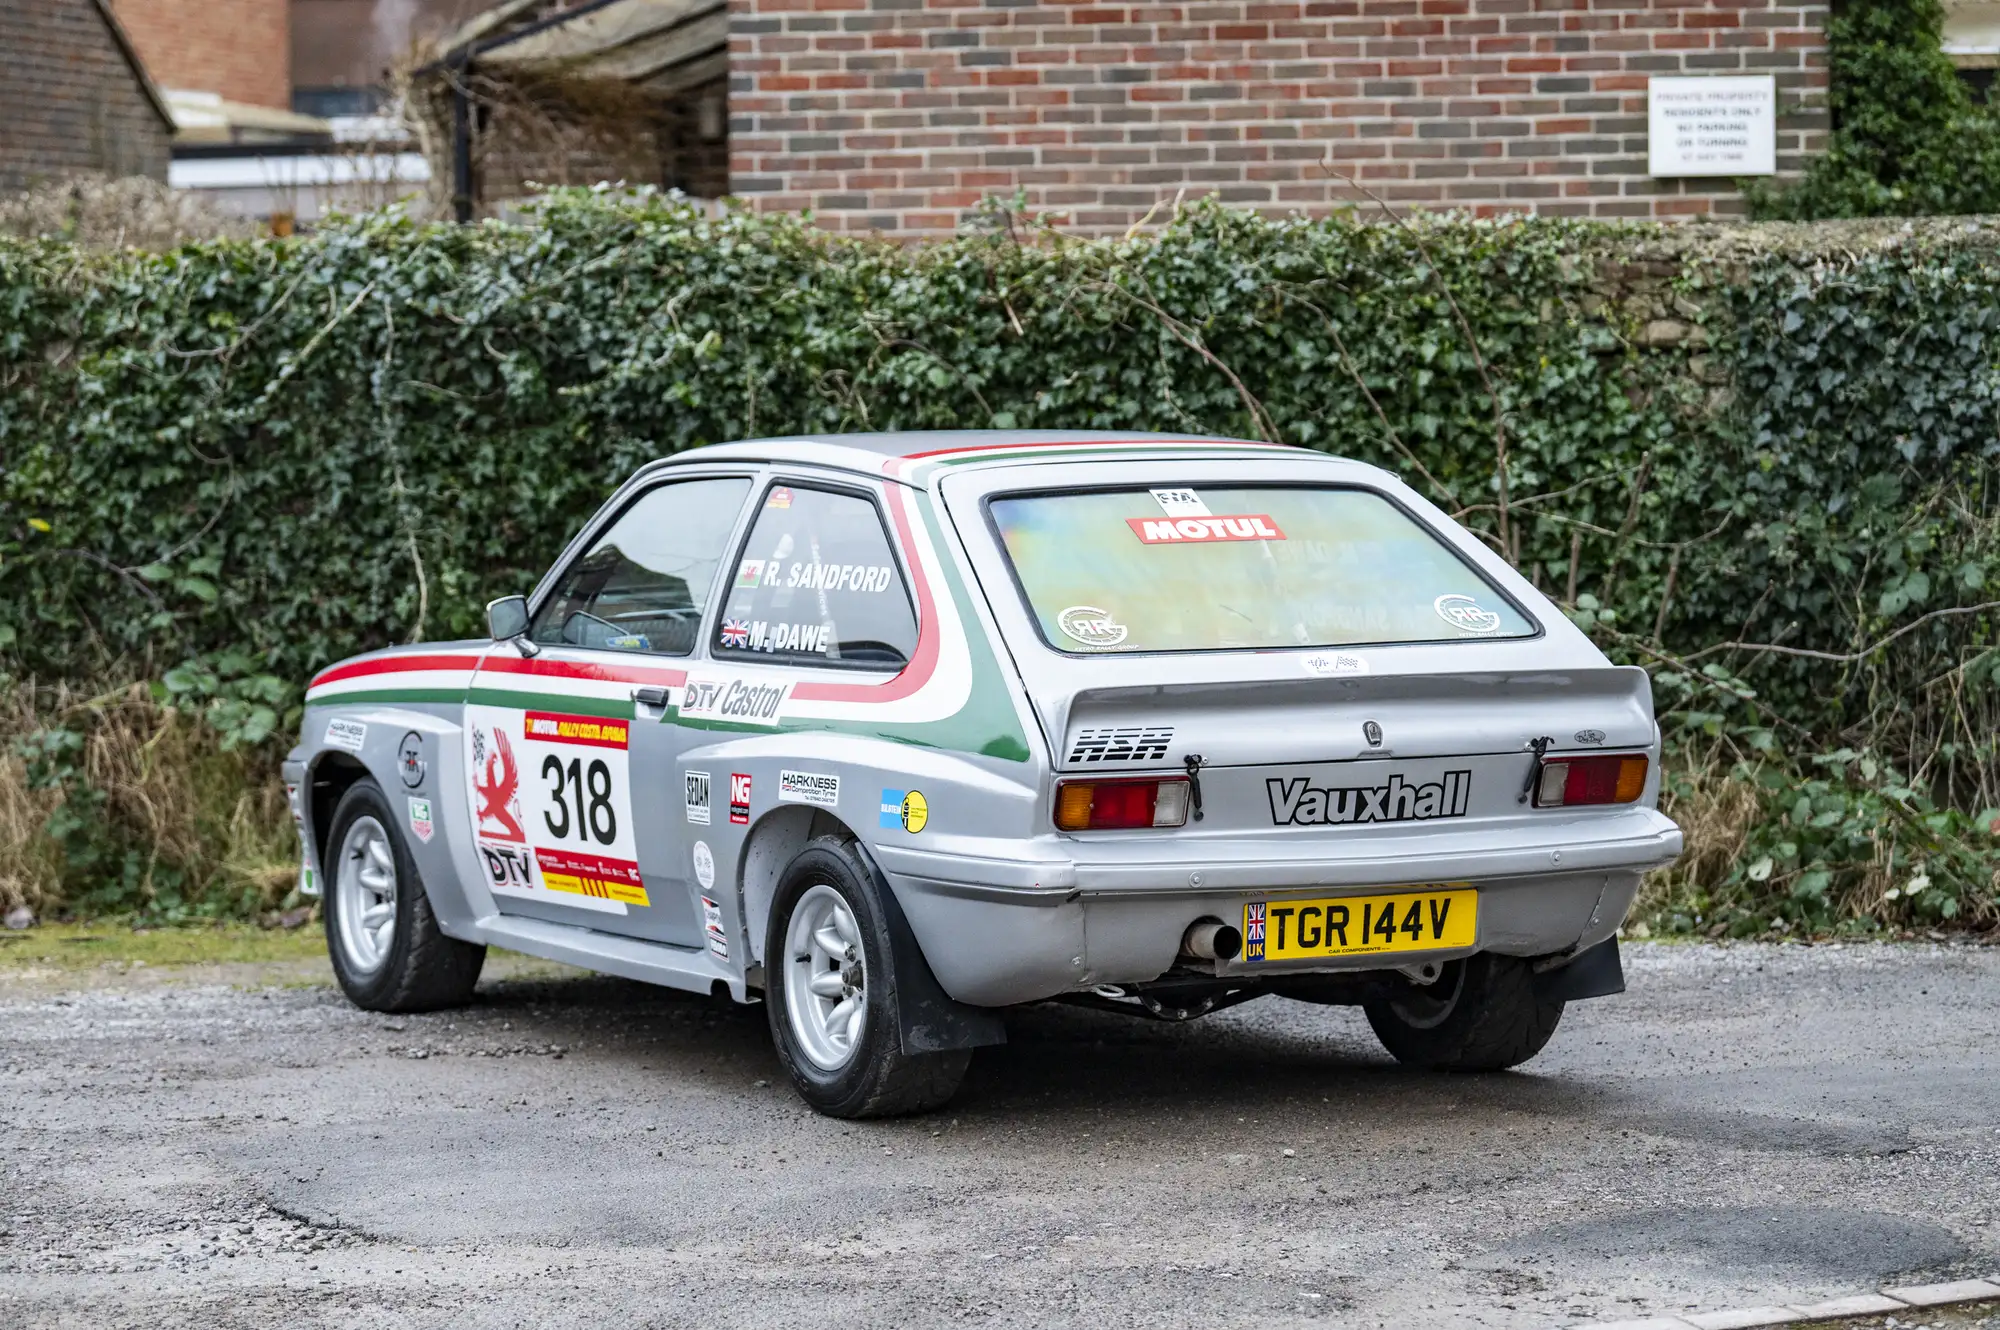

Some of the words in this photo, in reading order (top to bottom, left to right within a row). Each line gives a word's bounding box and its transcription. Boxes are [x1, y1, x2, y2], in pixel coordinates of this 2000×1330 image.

[1698, 123, 1748, 132] PARKING
[1142, 518, 1276, 540] MOTUL
[764, 561, 782, 587] R.
[787, 562, 891, 593] SANDFORD
[749, 621, 769, 648] M.
[774, 622, 830, 653] DAWE
[682, 681, 725, 710] DTV
[721, 680, 787, 718] Castrol
[1069, 727, 1174, 762] HSR
[687, 776, 708, 807] SEDAN
[731, 775, 751, 804] NG
[782, 773, 837, 790] HARKNESS
[792, 785, 822, 795] Competition
[822, 789, 837, 798] Tyres
[1266, 770, 1472, 825] Vauxhall
[541, 754, 617, 846] 318
[480, 846, 532, 887] DTV
[1271, 905, 1350, 950] TGR
[1362, 898, 1452, 945] 144V
[1248, 943, 1264, 957] UK
